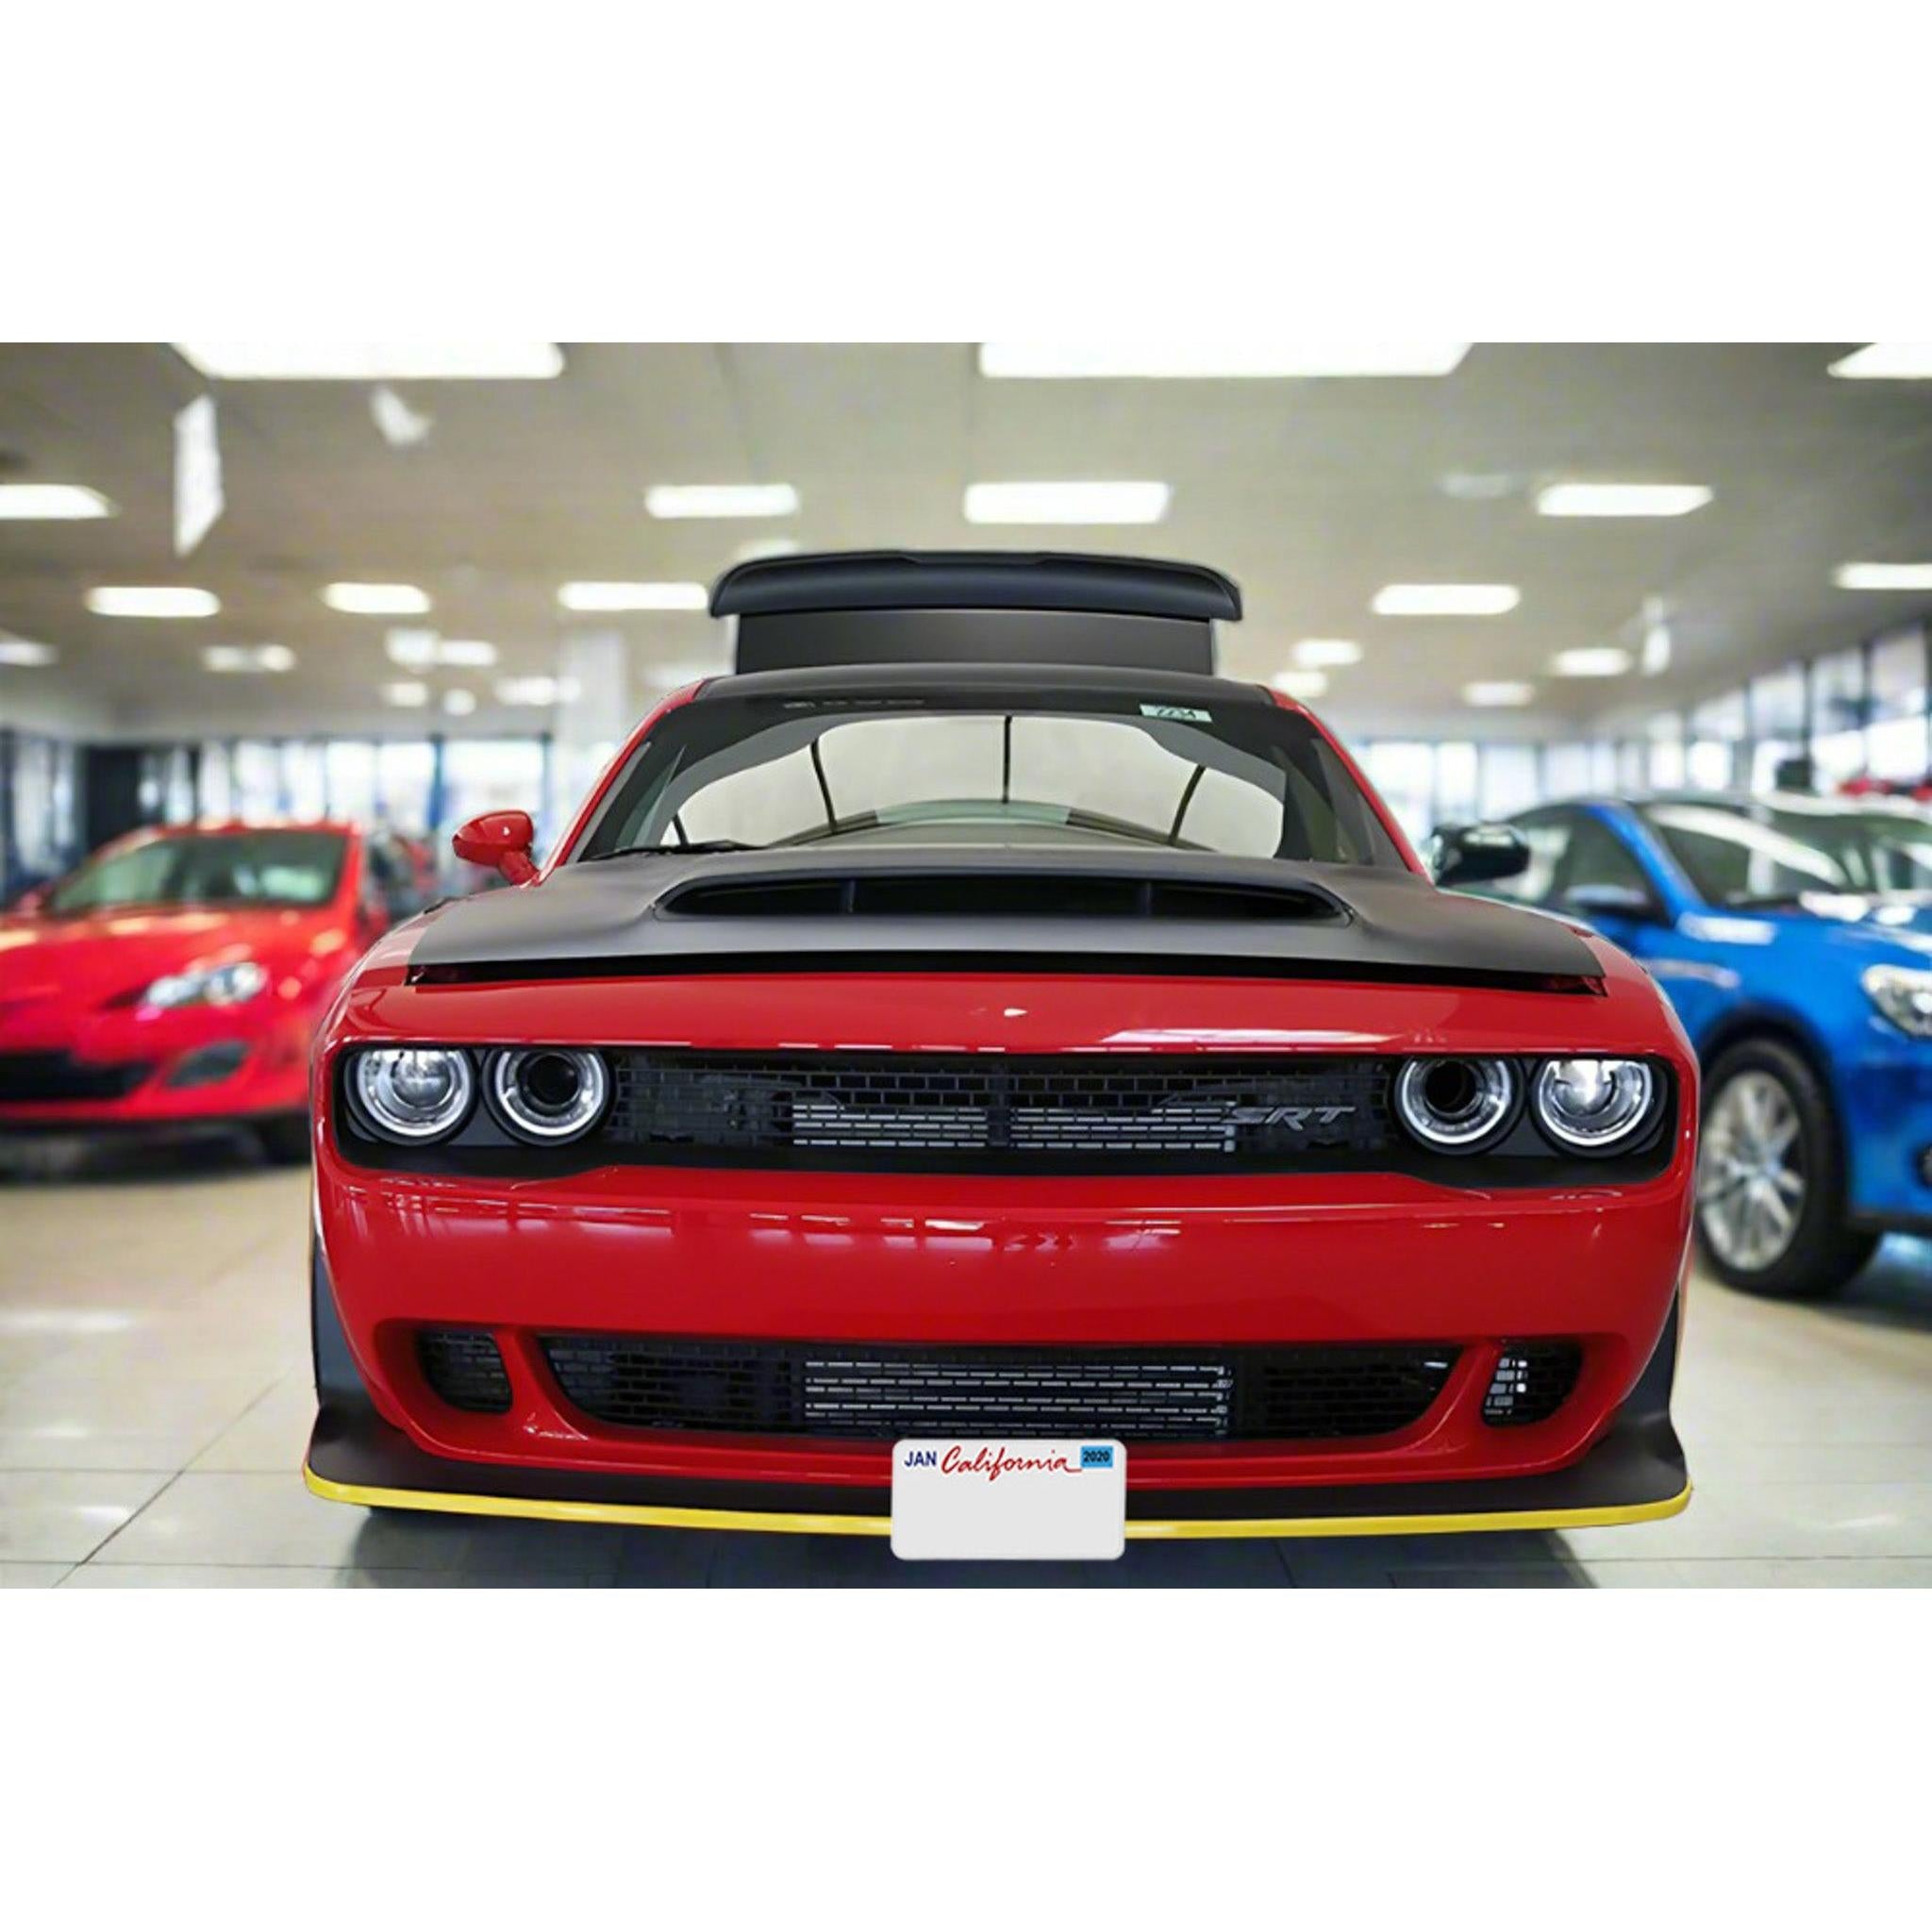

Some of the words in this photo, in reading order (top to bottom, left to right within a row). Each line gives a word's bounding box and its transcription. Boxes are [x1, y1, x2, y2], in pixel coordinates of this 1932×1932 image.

[1222, 1107, 1356, 1131] SRT
[904, 1451, 937, 1467] JAN
[941, 1445, 1082, 1481] California
[1083, 1450, 1110, 1462] 2020
